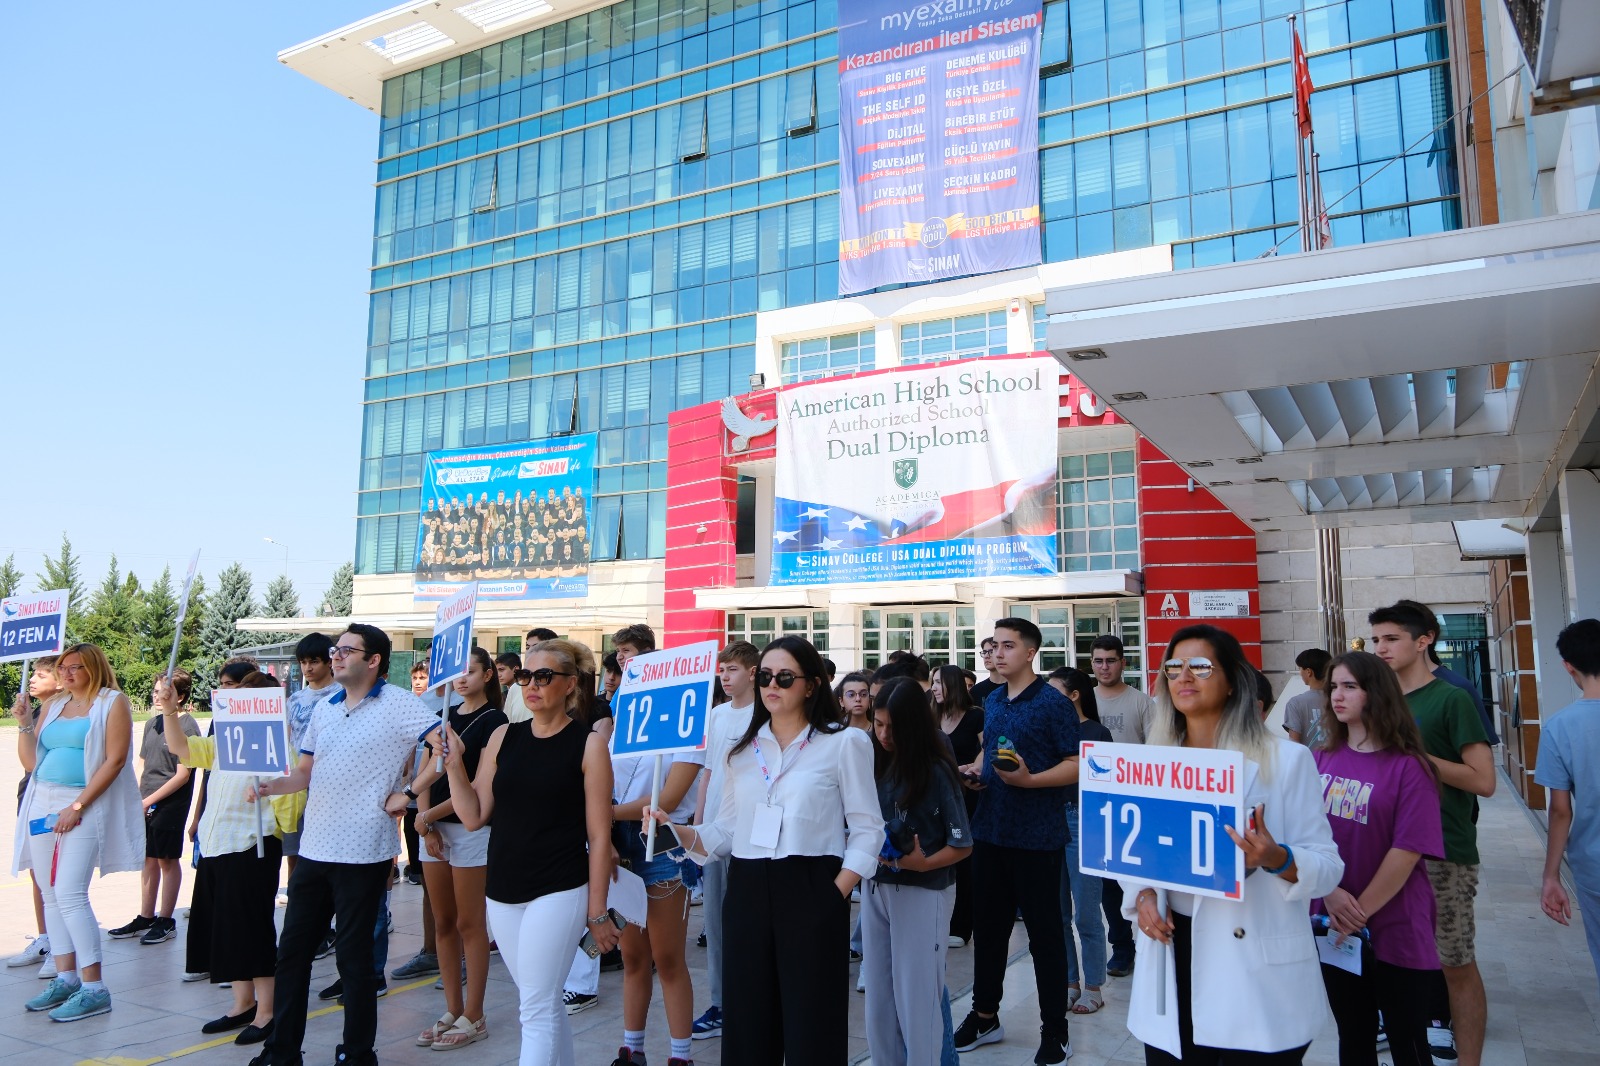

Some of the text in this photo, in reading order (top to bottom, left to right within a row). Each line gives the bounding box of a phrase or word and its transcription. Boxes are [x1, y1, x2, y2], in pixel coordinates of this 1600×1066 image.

[845, 38, 934, 70] Kazandıran
[977, 13, 1037, 39] Sistem
[946, 42, 1027, 70] DENEME KULÜBÜ
[885, 65, 926, 84] BIG FIVE
[982, 79, 1008, 93] ÖZEL
[862, 94, 926, 116] THE SELF ID
[989, 106, 1016, 122] ETÜT
[944, 138, 1012, 158] GÜÇLÜ YAYIN
[872, 153, 925, 171] SOLVEXAMY
[983, 165, 1017, 183] KADRO
[873, 183, 924, 200] LIVEXAMY
[965, 218, 986, 230] 500
[965, 228, 980, 239] LGS
[982, 224, 1010, 236] Türkiye
[927, 254, 960, 273] SINAV
[790, 390, 885, 420] American
[893, 376, 951, 405] High
[958, 368, 1042, 395] School
[827, 399, 990, 435] Authorized School
[826, 424, 989, 461] Dual Diploma
[537, 460, 567, 476] SINAV
[875, 490, 940, 504] ACADEMICA
[842, 551, 883, 565] COLLEGE
[891, 549, 910, 561] USA
[913, 546, 936, 559] DUAL
[940, 543, 983, 558] DIPLOMA
[18, 596, 61, 617] SINAV KOLEJİ
[1160, 593, 1180, 611] A
[2, 624, 57, 647] 12 FEN A
[433, 634, 447, 677] 12
[454, 624, 466, 667] B
[641, 651, 712, 683] SINAV KOLEJİ
[228, 697, 251, 715] SINAV
[253, 695, 283, 715] KOLEJİ
[626, 695, 653, 745] 12
[677, 688, 697, 739] C
[224, 725, 246, 765] 12
[266, 725, 279, 768] A
[1116, 757, 1235, 794] SINAV KOLEJİ
[1100, 800, 1142, 867] 12
[1190, 810, 1215, 877] D
